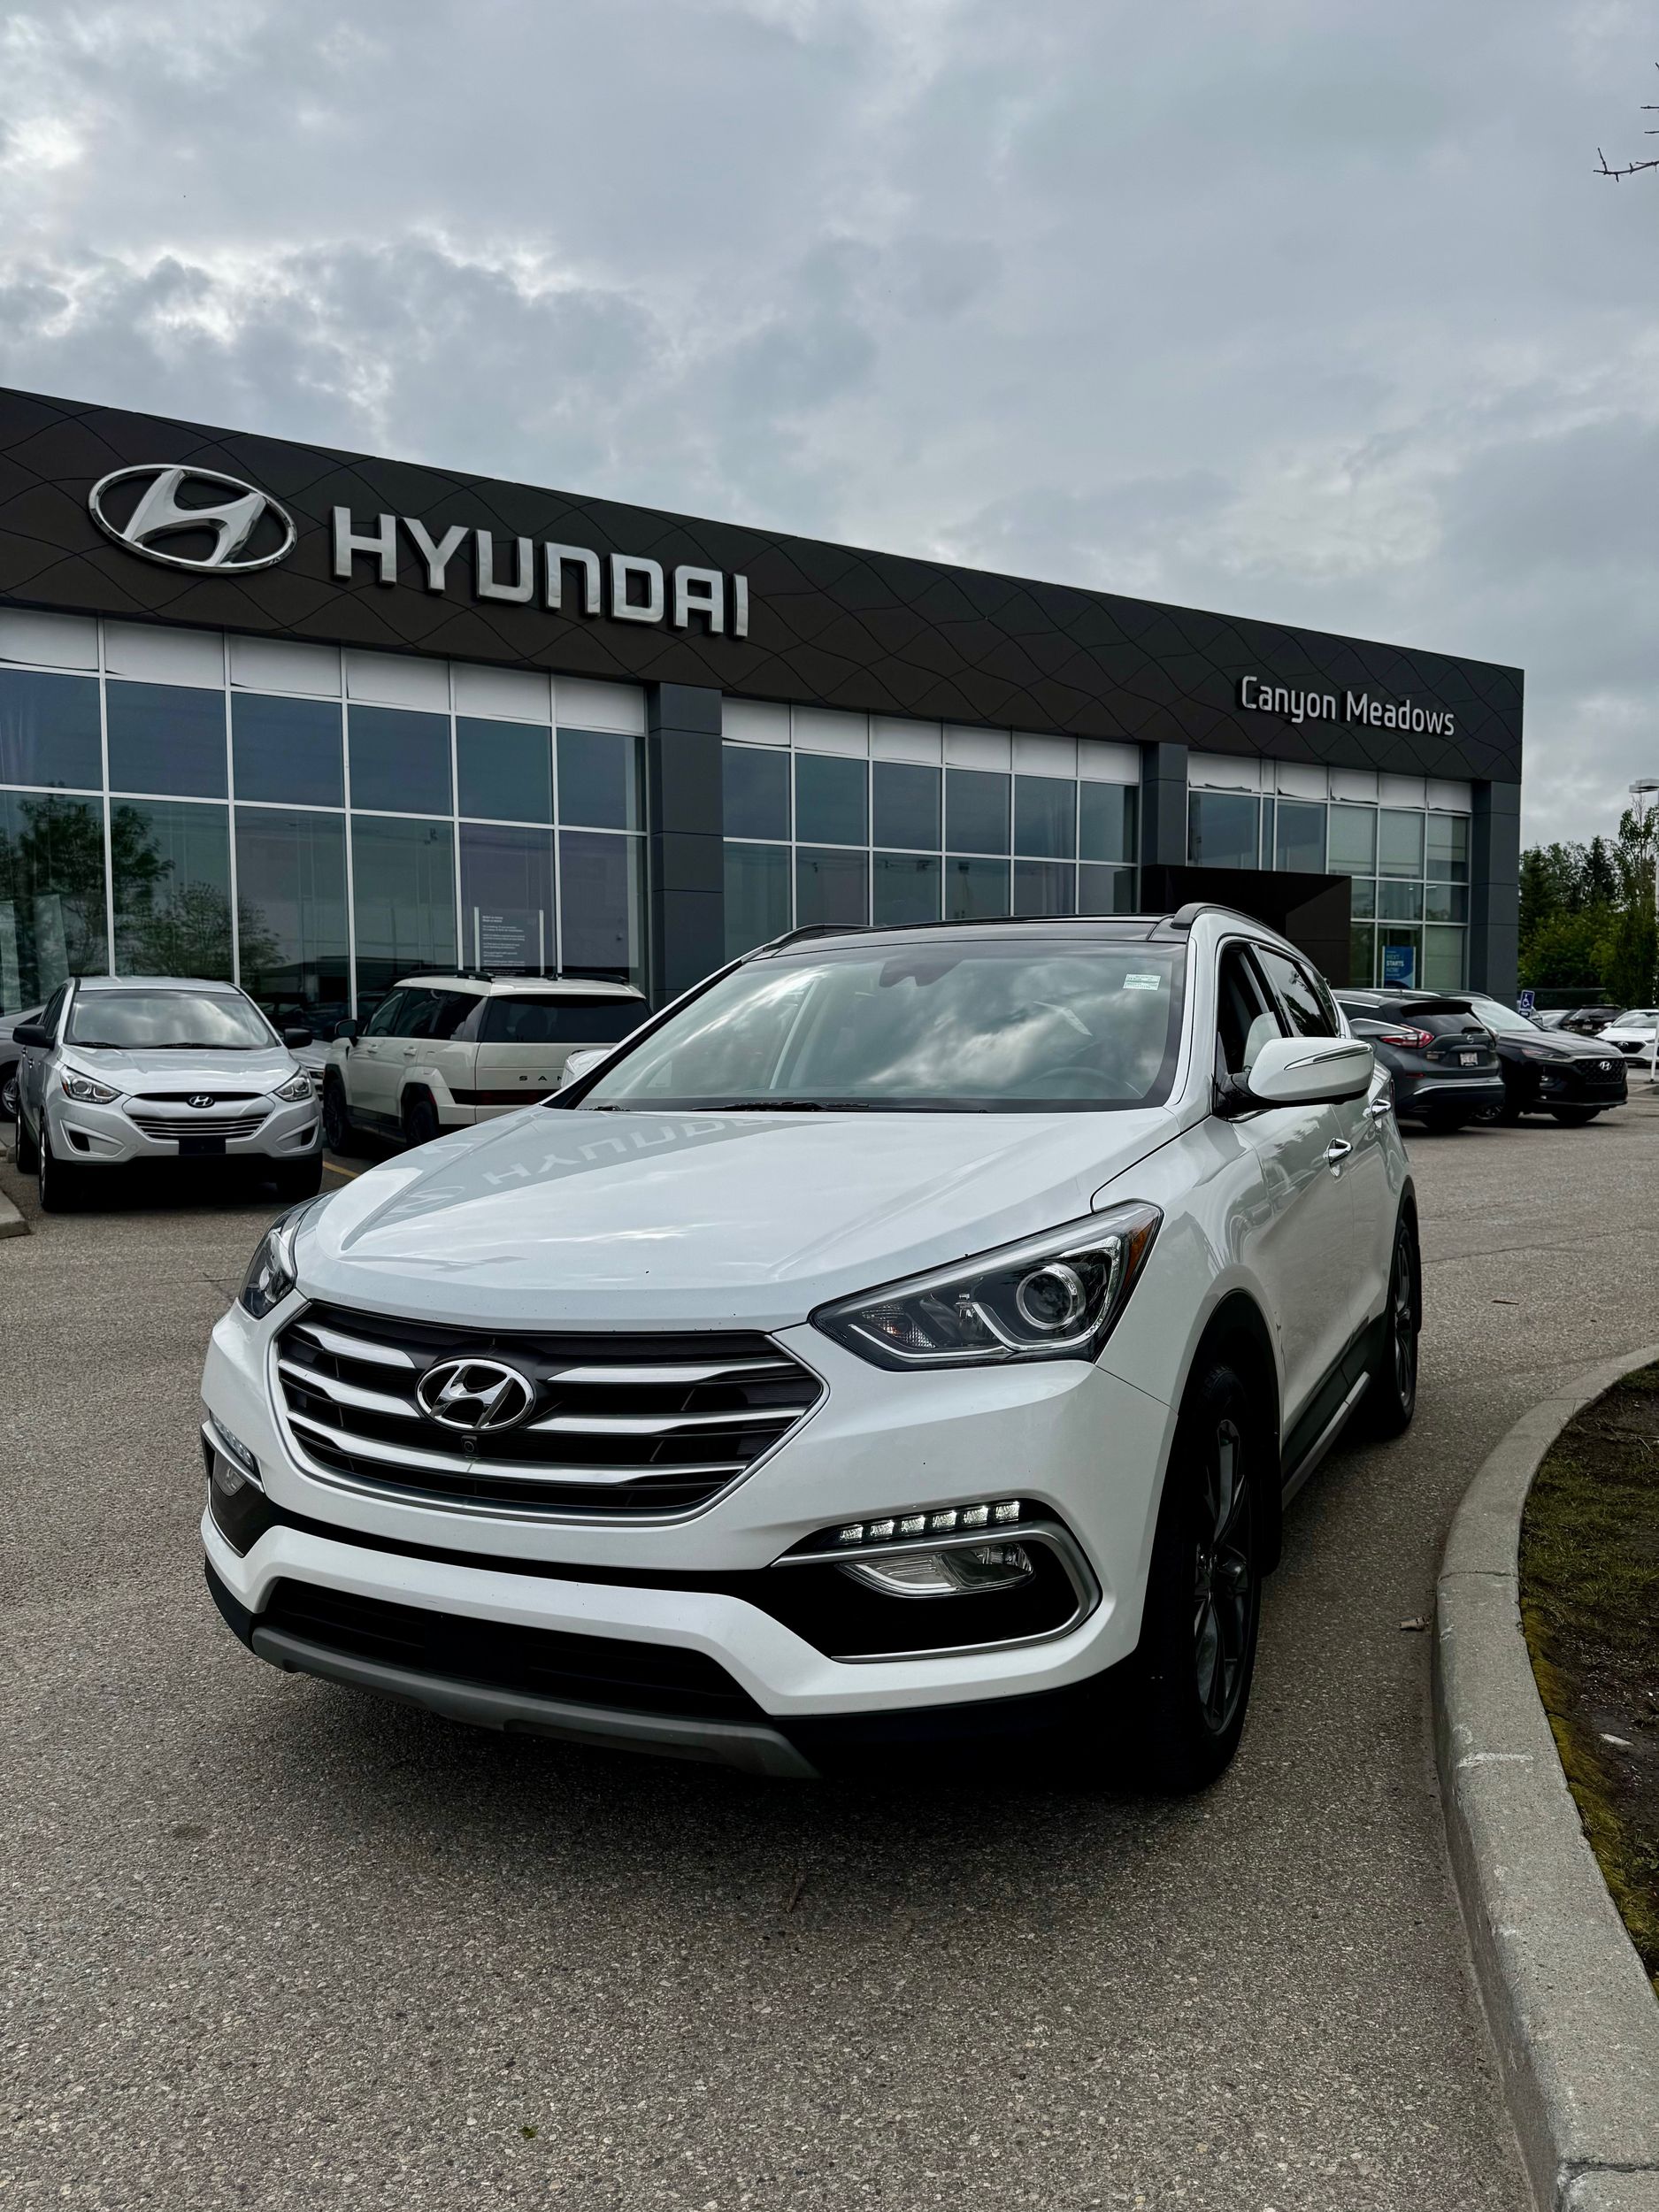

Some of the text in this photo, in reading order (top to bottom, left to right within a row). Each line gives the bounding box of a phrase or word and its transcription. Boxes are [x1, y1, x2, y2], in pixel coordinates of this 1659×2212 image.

[333, 505, 749, 637] HYUNDAI
[1241, 676, 1455, 736] Canyon Meadows
